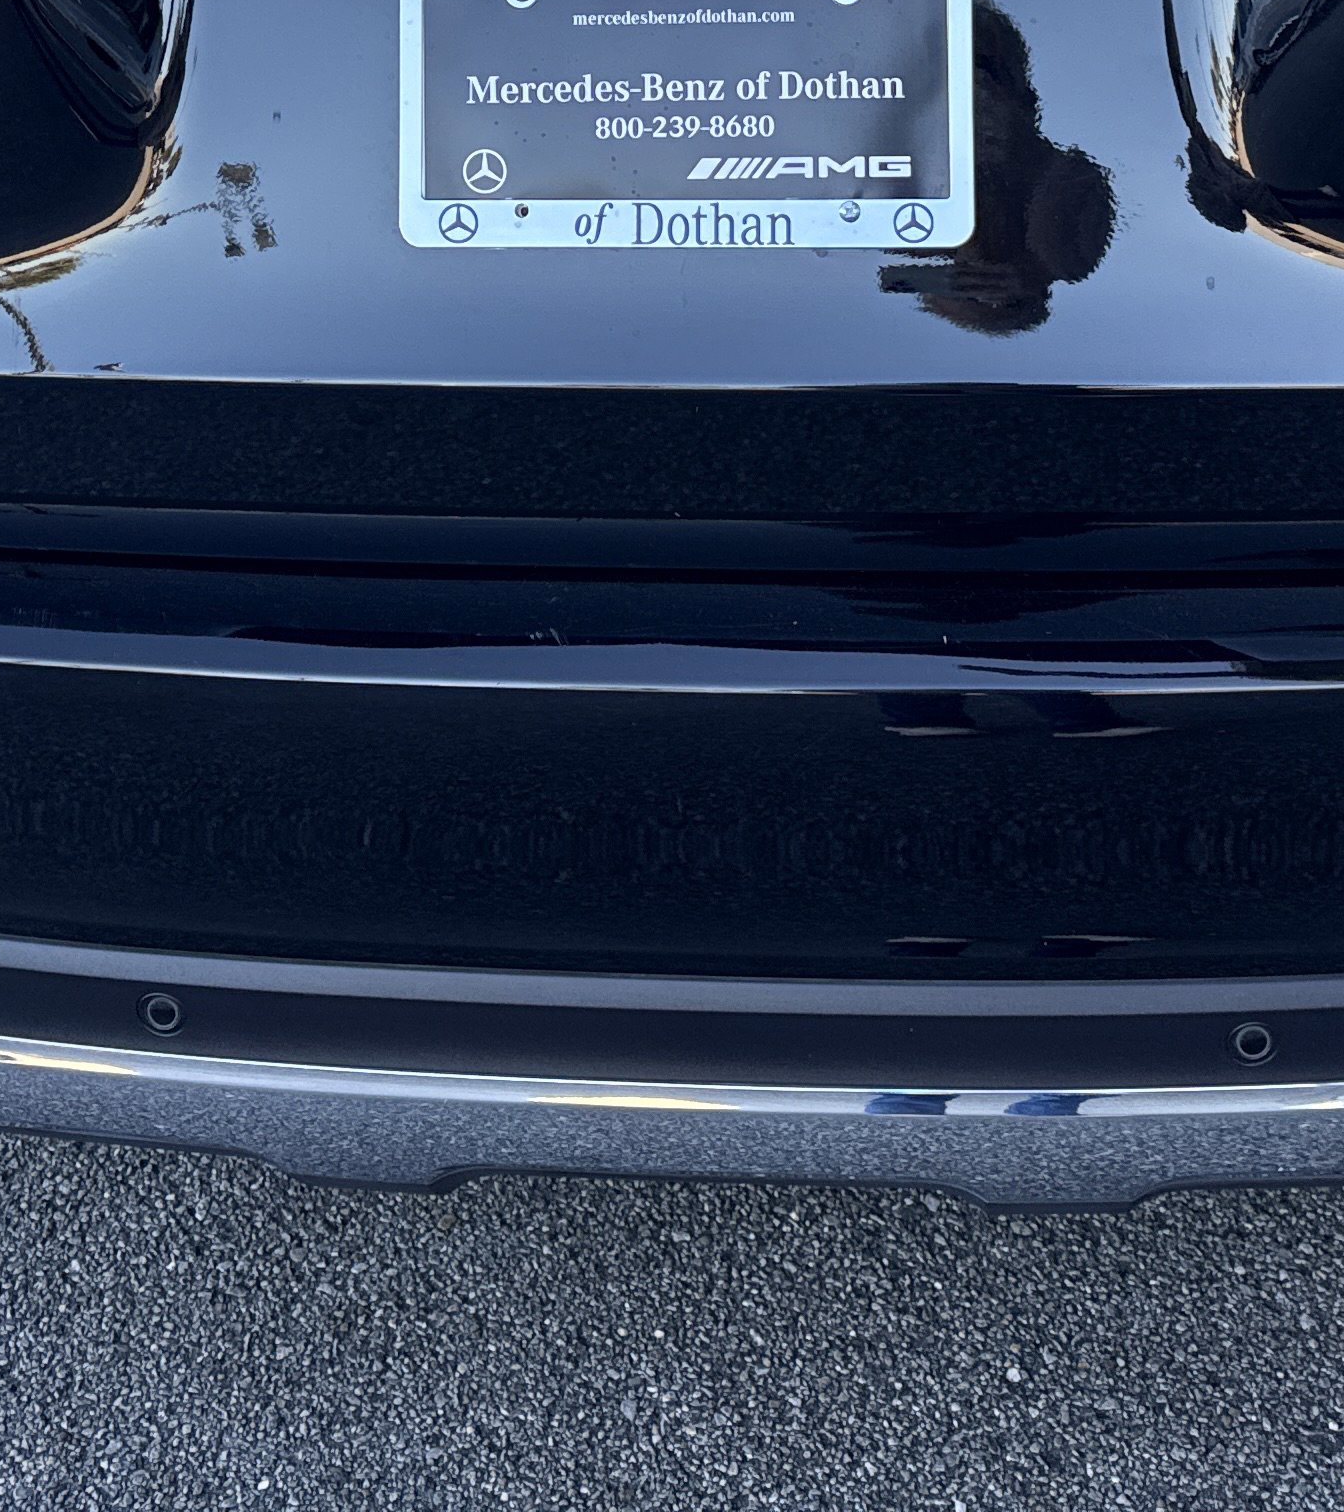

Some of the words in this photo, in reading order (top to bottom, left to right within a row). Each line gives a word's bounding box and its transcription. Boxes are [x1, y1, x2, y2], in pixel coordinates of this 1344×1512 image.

[573, 8, 795, 26] mercedesbenzofdothan.com
[466, 74, 725, 105] Mercedes-Benz
[737, 72, 772, 102] of
[778, 70, 905, 100] Dothan
[595, 116, 775, 139] 800-239-8680
[772, 156, 912, 178] AMG
[574, 202, 613, 244] of
[632, 202, 795, 246] Dothan
